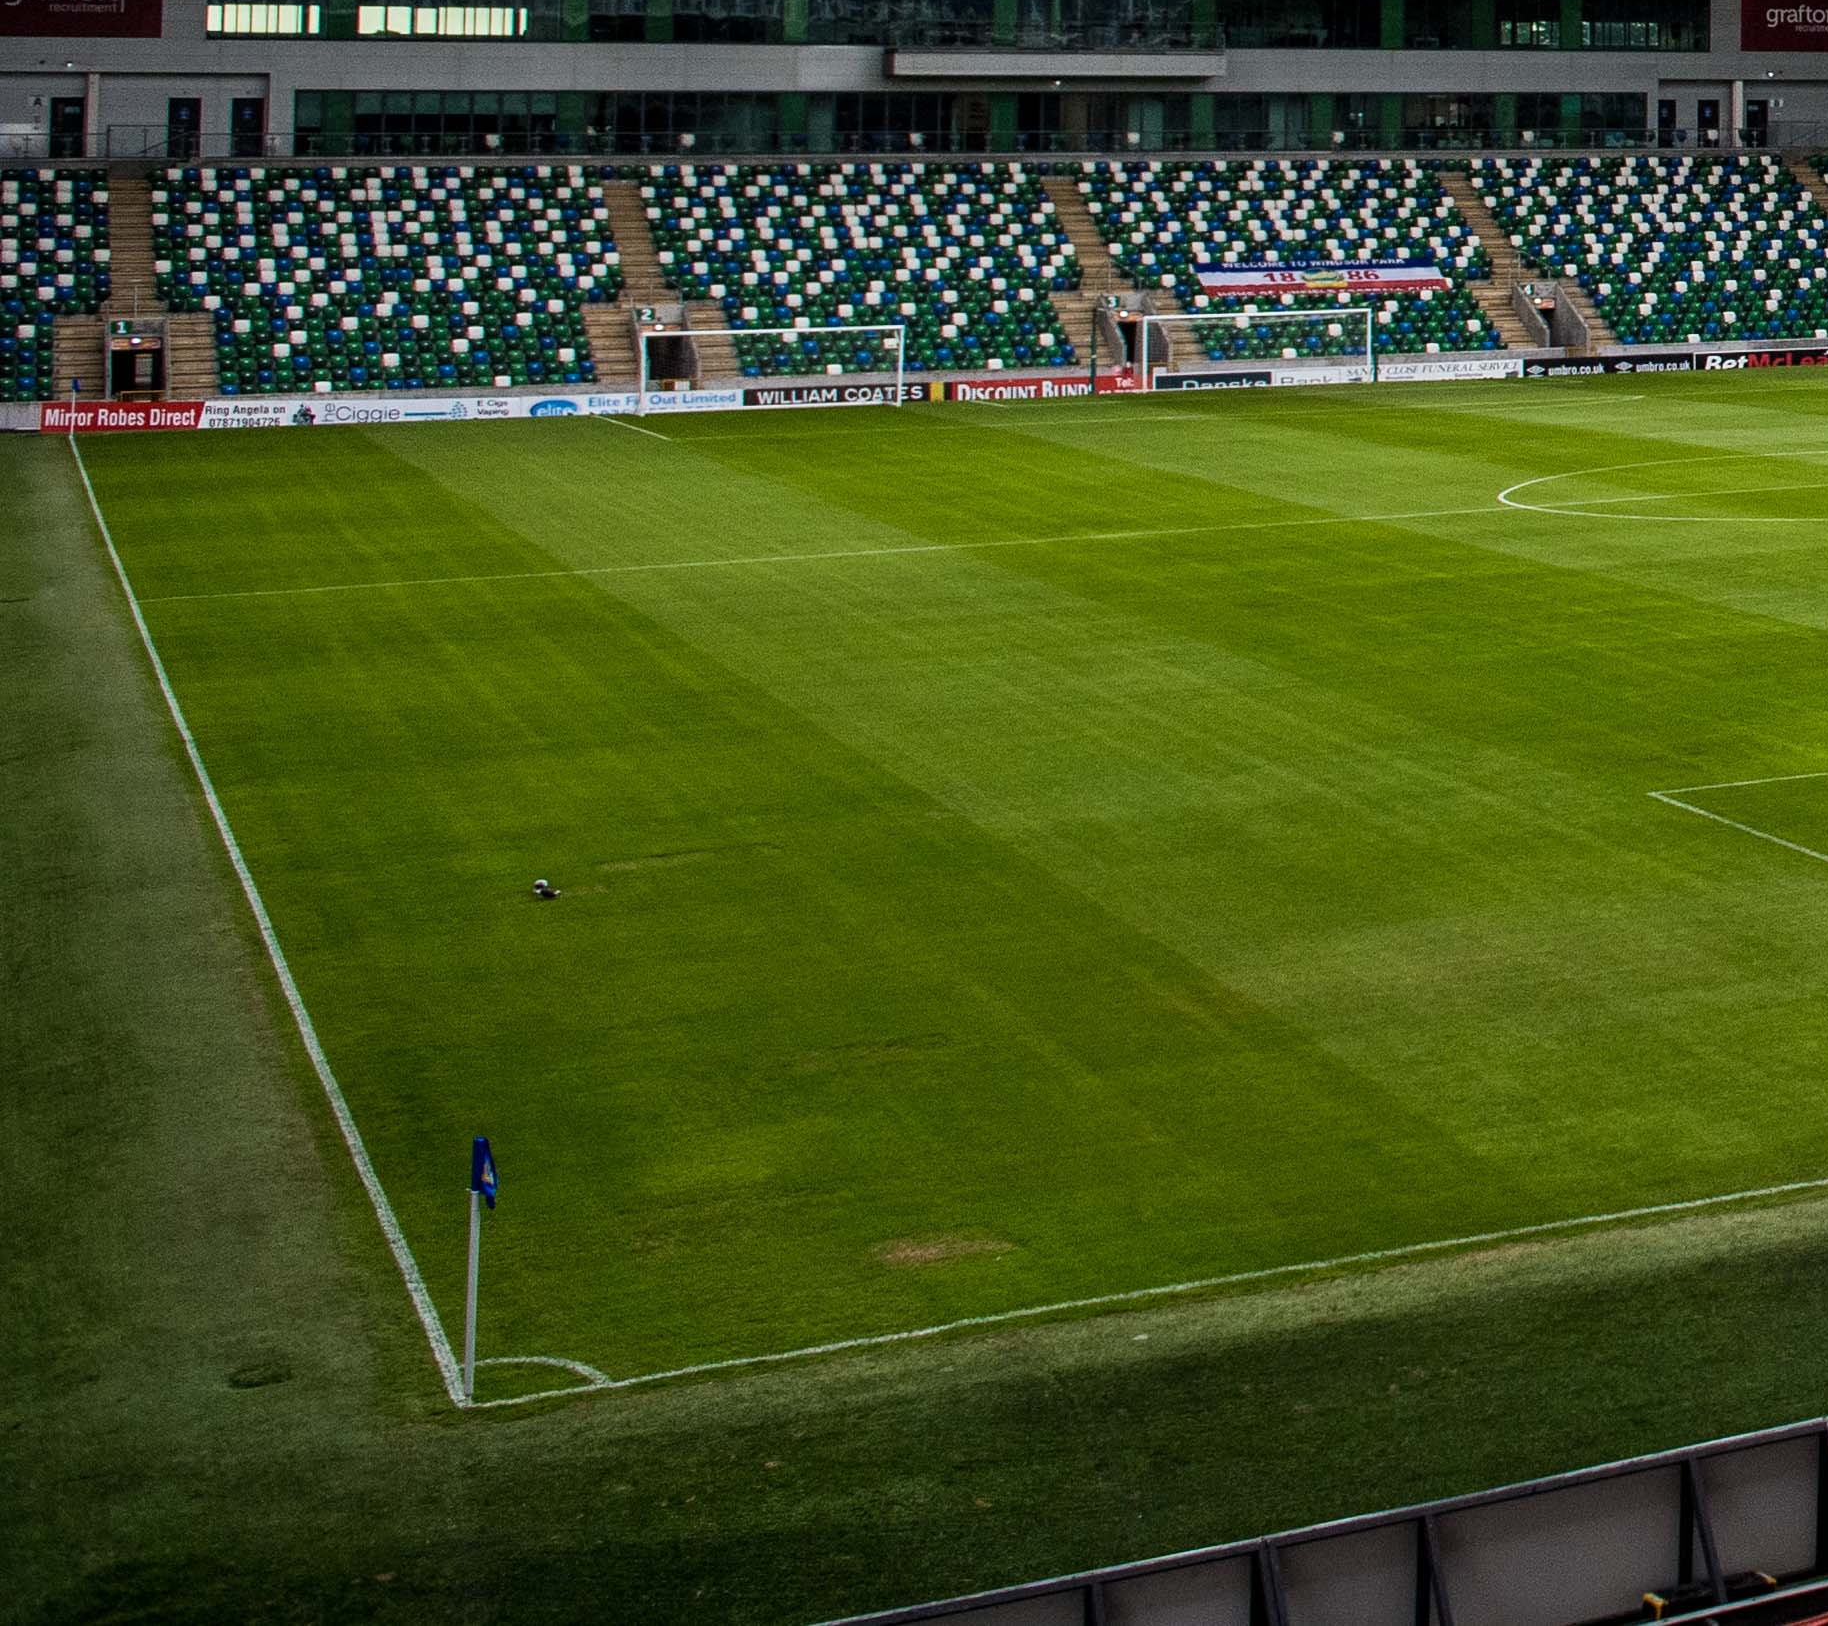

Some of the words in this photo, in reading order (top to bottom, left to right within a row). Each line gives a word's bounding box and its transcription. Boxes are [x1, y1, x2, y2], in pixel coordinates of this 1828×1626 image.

[49, 3, 118, 13] recruitment
[1264, 272, 1296, 282] 18
[1347, 270, 1379, 280] 86
[1107, 296, 1117, 308] 3
[641, 308, 653, 321] 2
[116, 321, 127, 334] 1
[1421, 363, 1474, 374] FUNERAL
[1477, 361, 1519, 371] SERVICE
[1548, 362, 1605, 376] umbro.co.uk
[1636, 359, 1691, 373] umbro.co.uk
[757, 389, 838, 405] WILLIAM
[844, 386, 924, 402] COATES
[957, 382, 1038, 401] DISCOUNT
[588, 395, 621, 407] Elite
[649, 393, 677, 405] Out
[682, 391, 737, 404] Limited
[45, 408, 94, 427] Mirror
[97, 408, 146, 427] Robes
[149, 408, 196, 426] Direct
[205, 405, 230, 419] Ring
[233, 404, 270, 418] Angela
[273, 405, 286, 415] on
[336, 405, 401, 423] Ciggie
